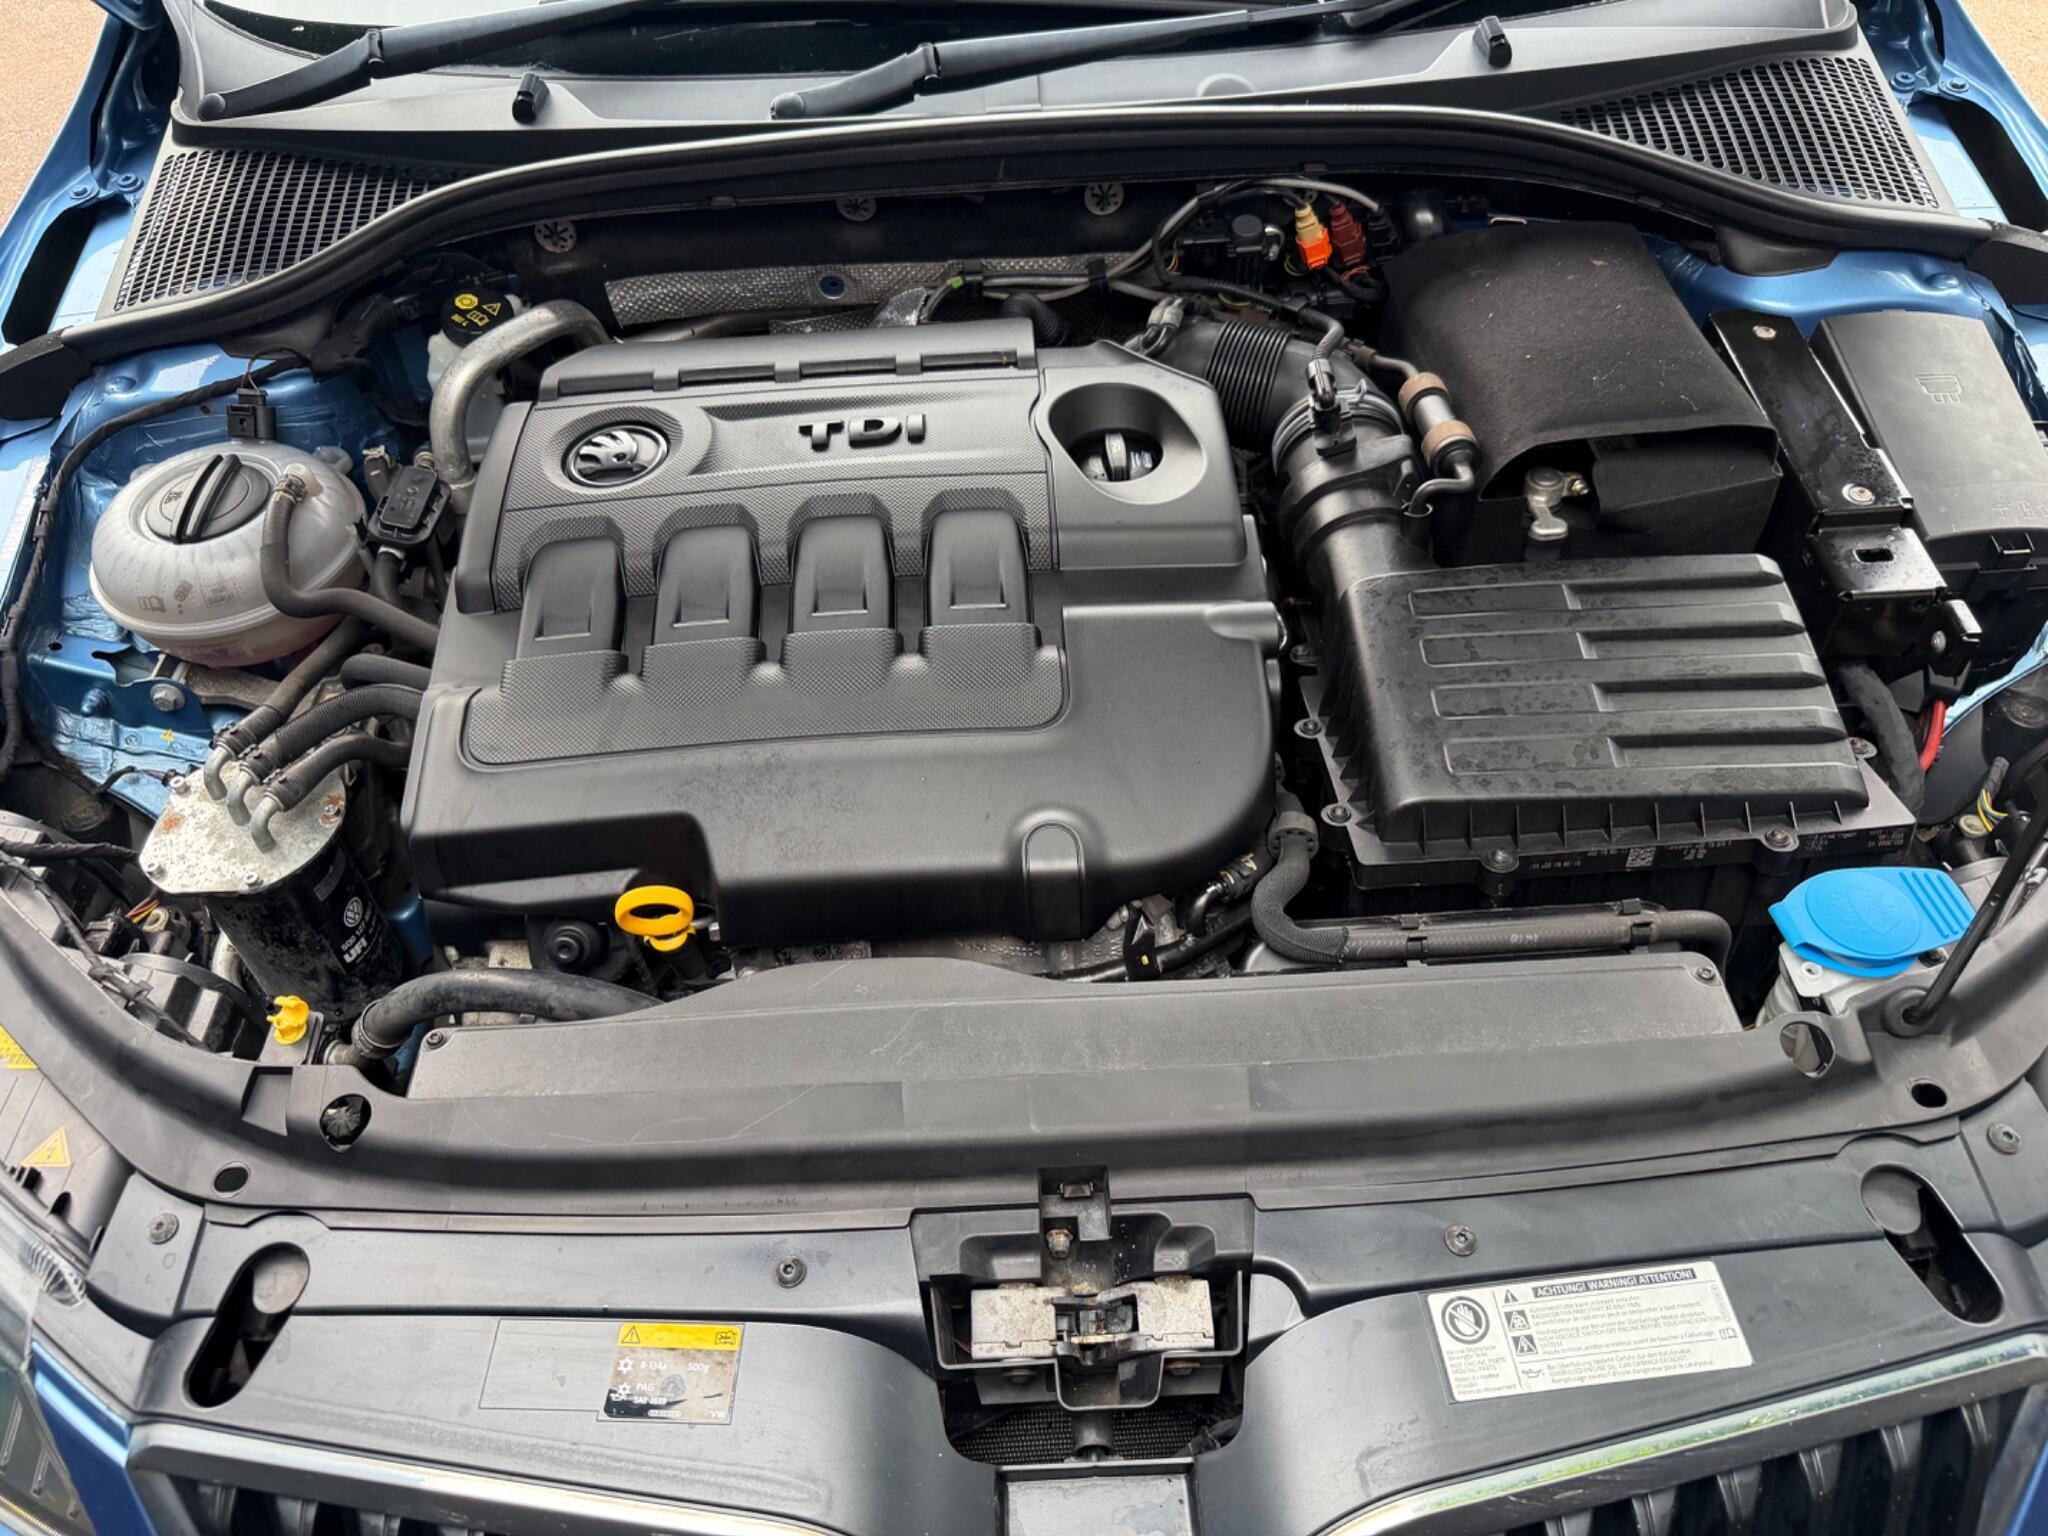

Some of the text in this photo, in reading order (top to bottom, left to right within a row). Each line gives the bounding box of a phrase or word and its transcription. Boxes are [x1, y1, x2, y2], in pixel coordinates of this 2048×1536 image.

[798, 412, 926, 452] TDI
[1535, 1268, 1693, 1296] ACHTUNG! WARNING! ATTENTION!
[687, 1362, 710, 1375] 500g
